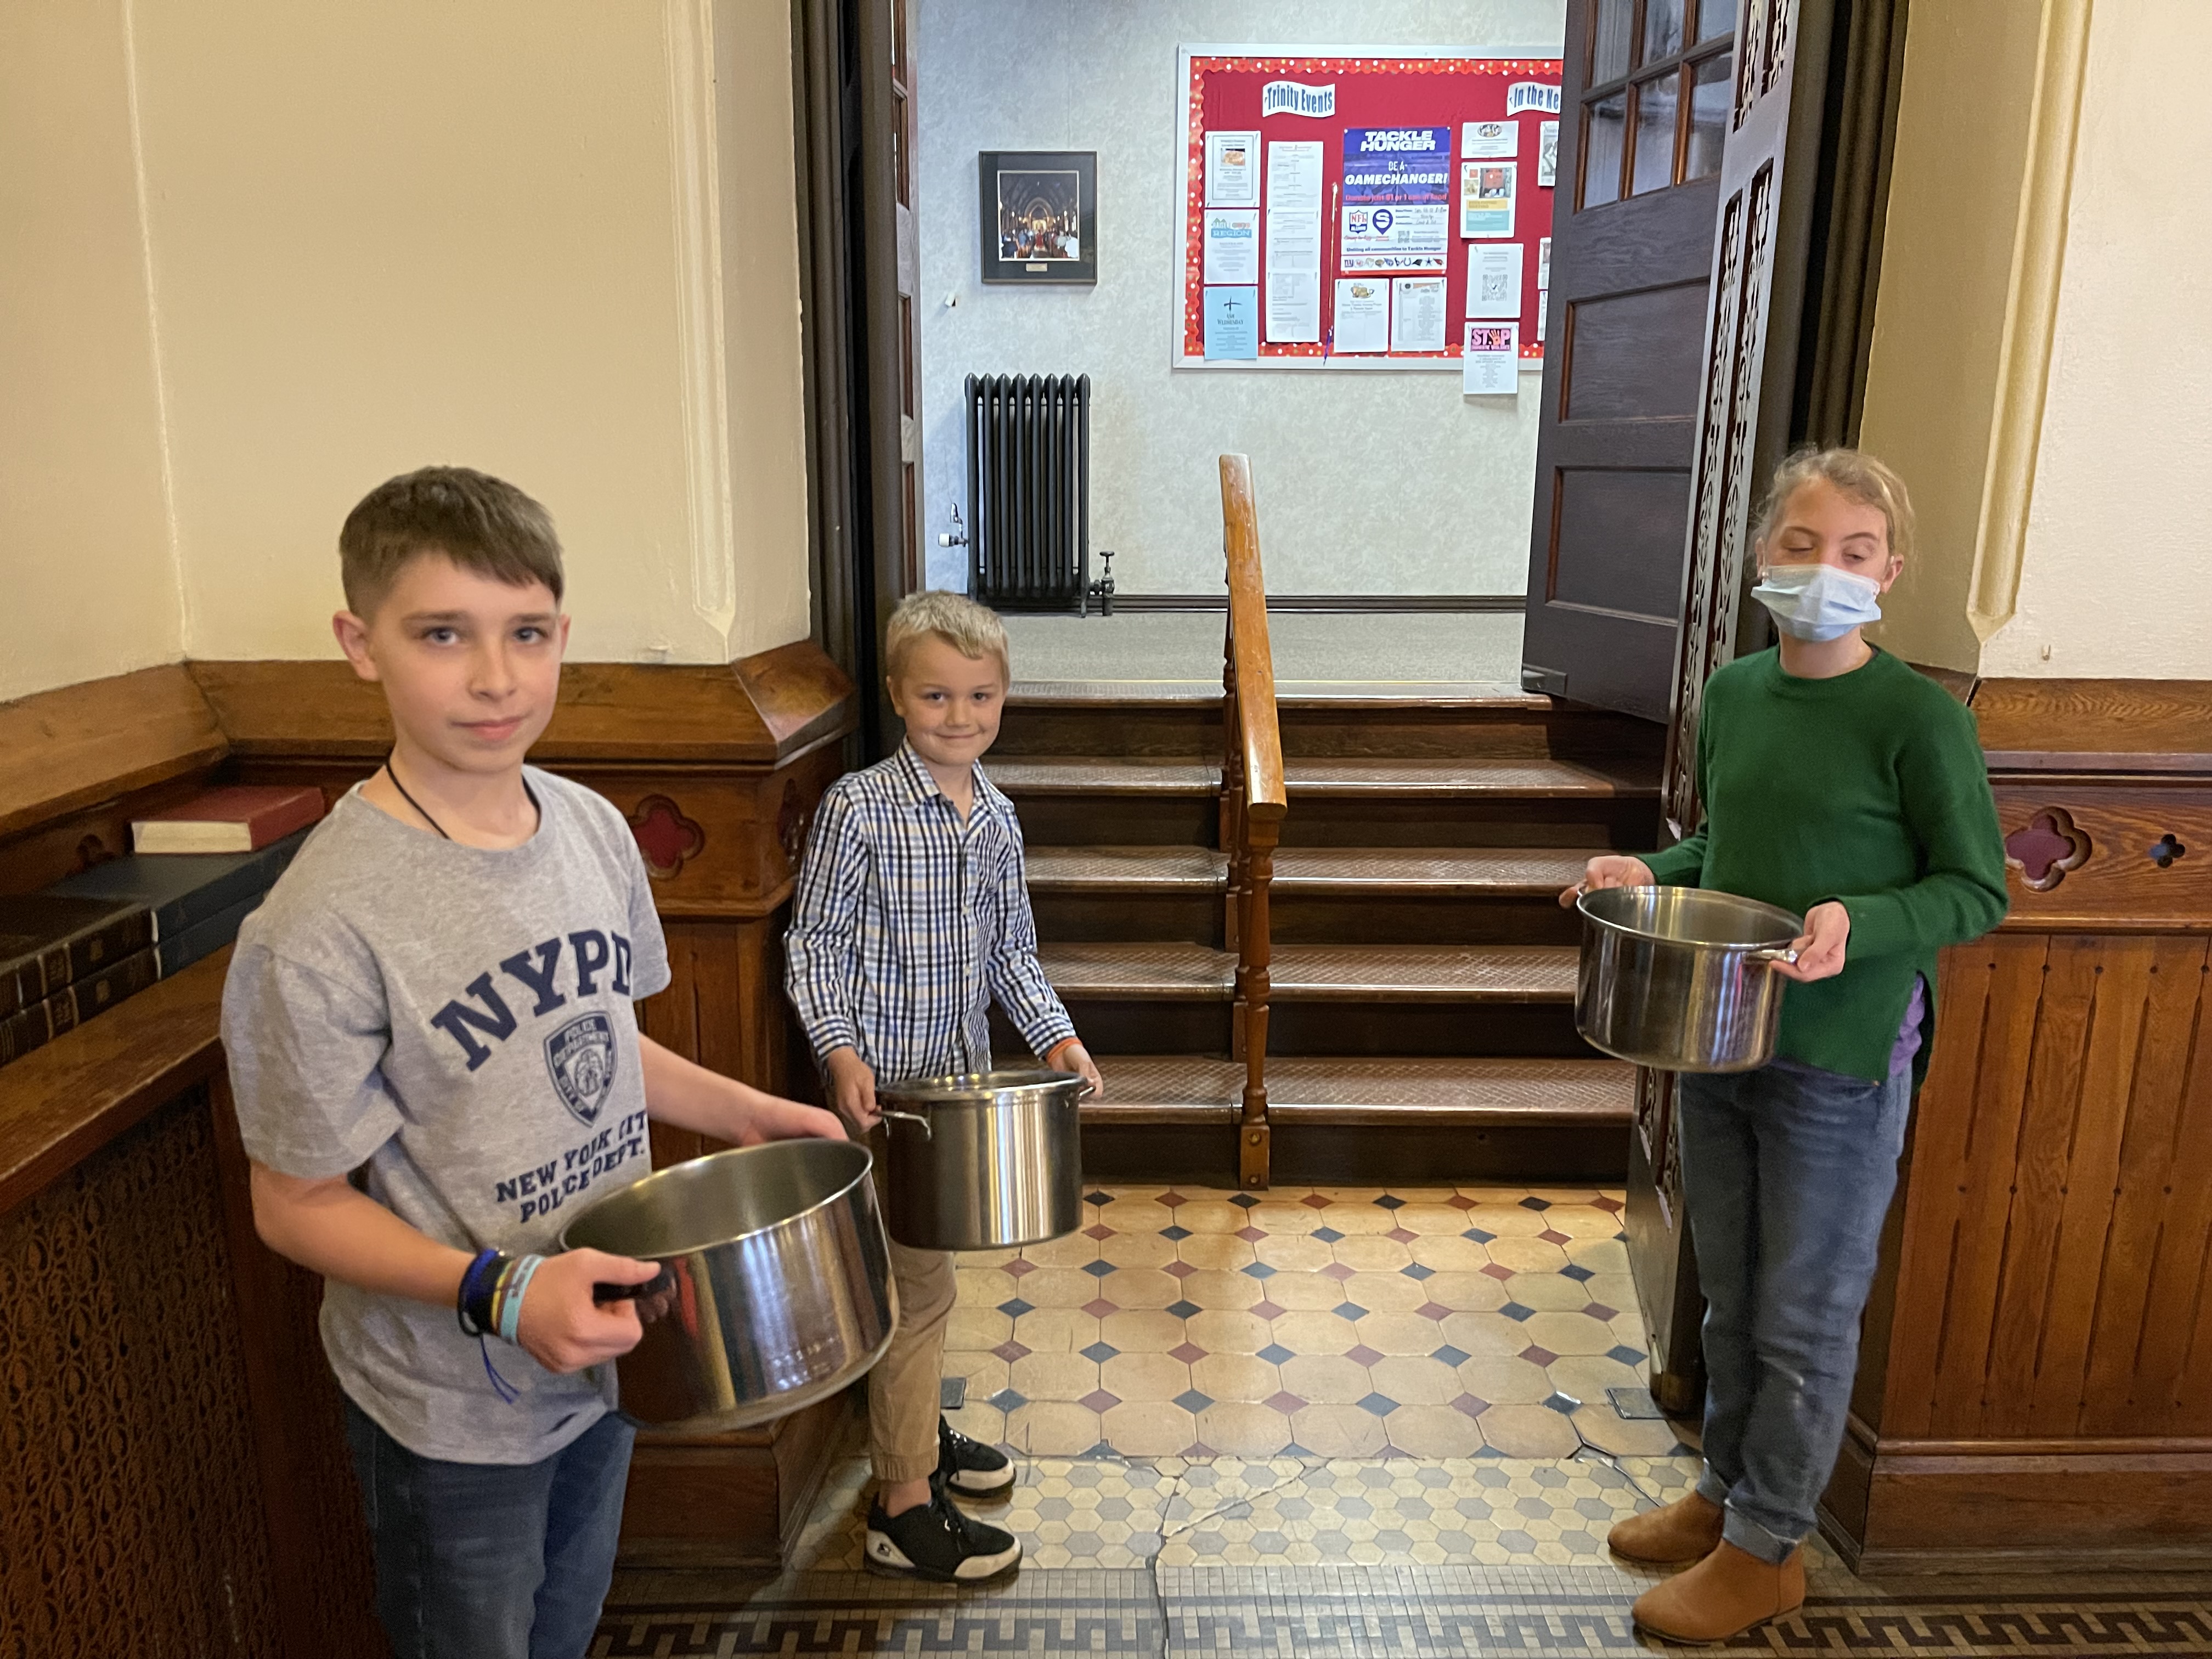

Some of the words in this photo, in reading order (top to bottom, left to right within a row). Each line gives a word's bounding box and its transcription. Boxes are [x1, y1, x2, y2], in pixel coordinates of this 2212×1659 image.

[1267, 84, 1299, 111] Trinity
[1301, 88, 1333, 113] Events
[1514, 87, 1524, 108] In
[1527, 84, 1543, 107] the
[1546, 88, 1559, 110] Ne
[1364, 130, 1433, 142] TACKLE
[1360, 140, 1436, 152] HUNGER
[1388, 161, 1398, 171] BE
[1345, 173, 1448, 185] GAMECHANGER!
[1351, 214, 1367, 222] NFL
[1471, 328, 1510, 346] STP
[496, 1160, 557, 1203] NEW
[520, 1169, 590, 1224] POLCE
